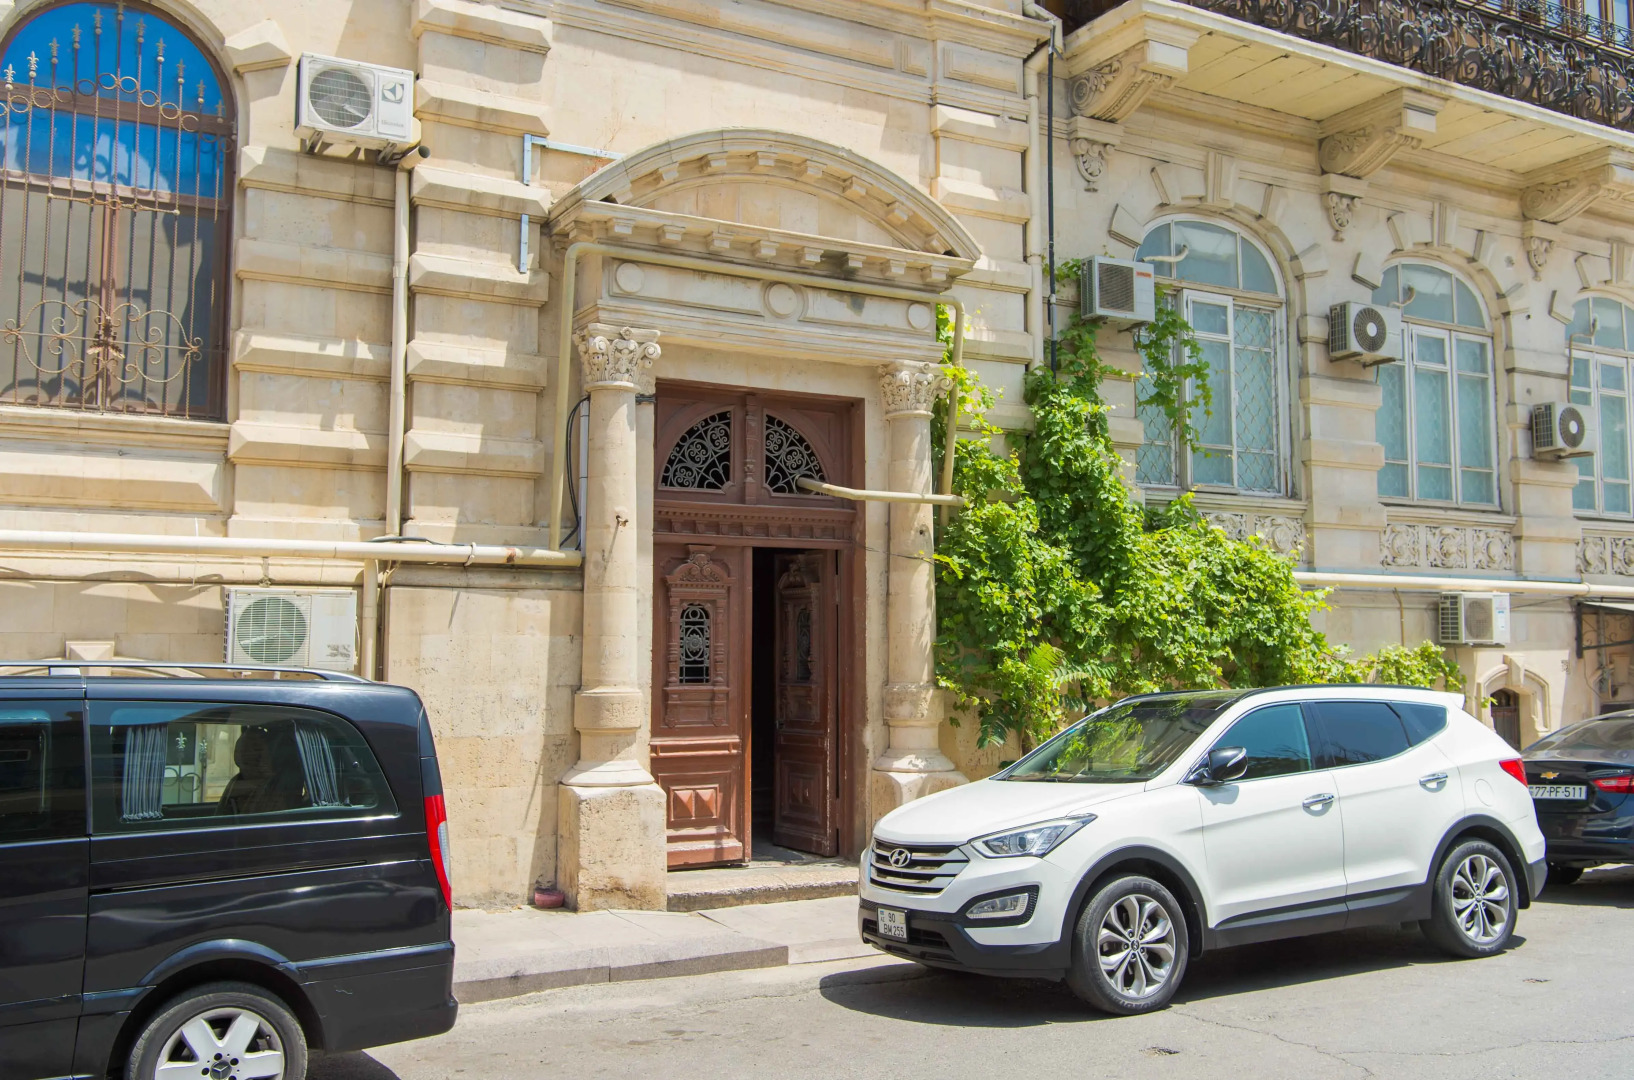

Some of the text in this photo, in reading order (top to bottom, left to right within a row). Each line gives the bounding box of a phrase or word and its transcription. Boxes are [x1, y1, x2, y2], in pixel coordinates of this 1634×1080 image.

[1535, 786, 1582, 798] 77-PF-511
[888, 912, 895, 923] 90
[884, 924, 904, 937] BM 255
